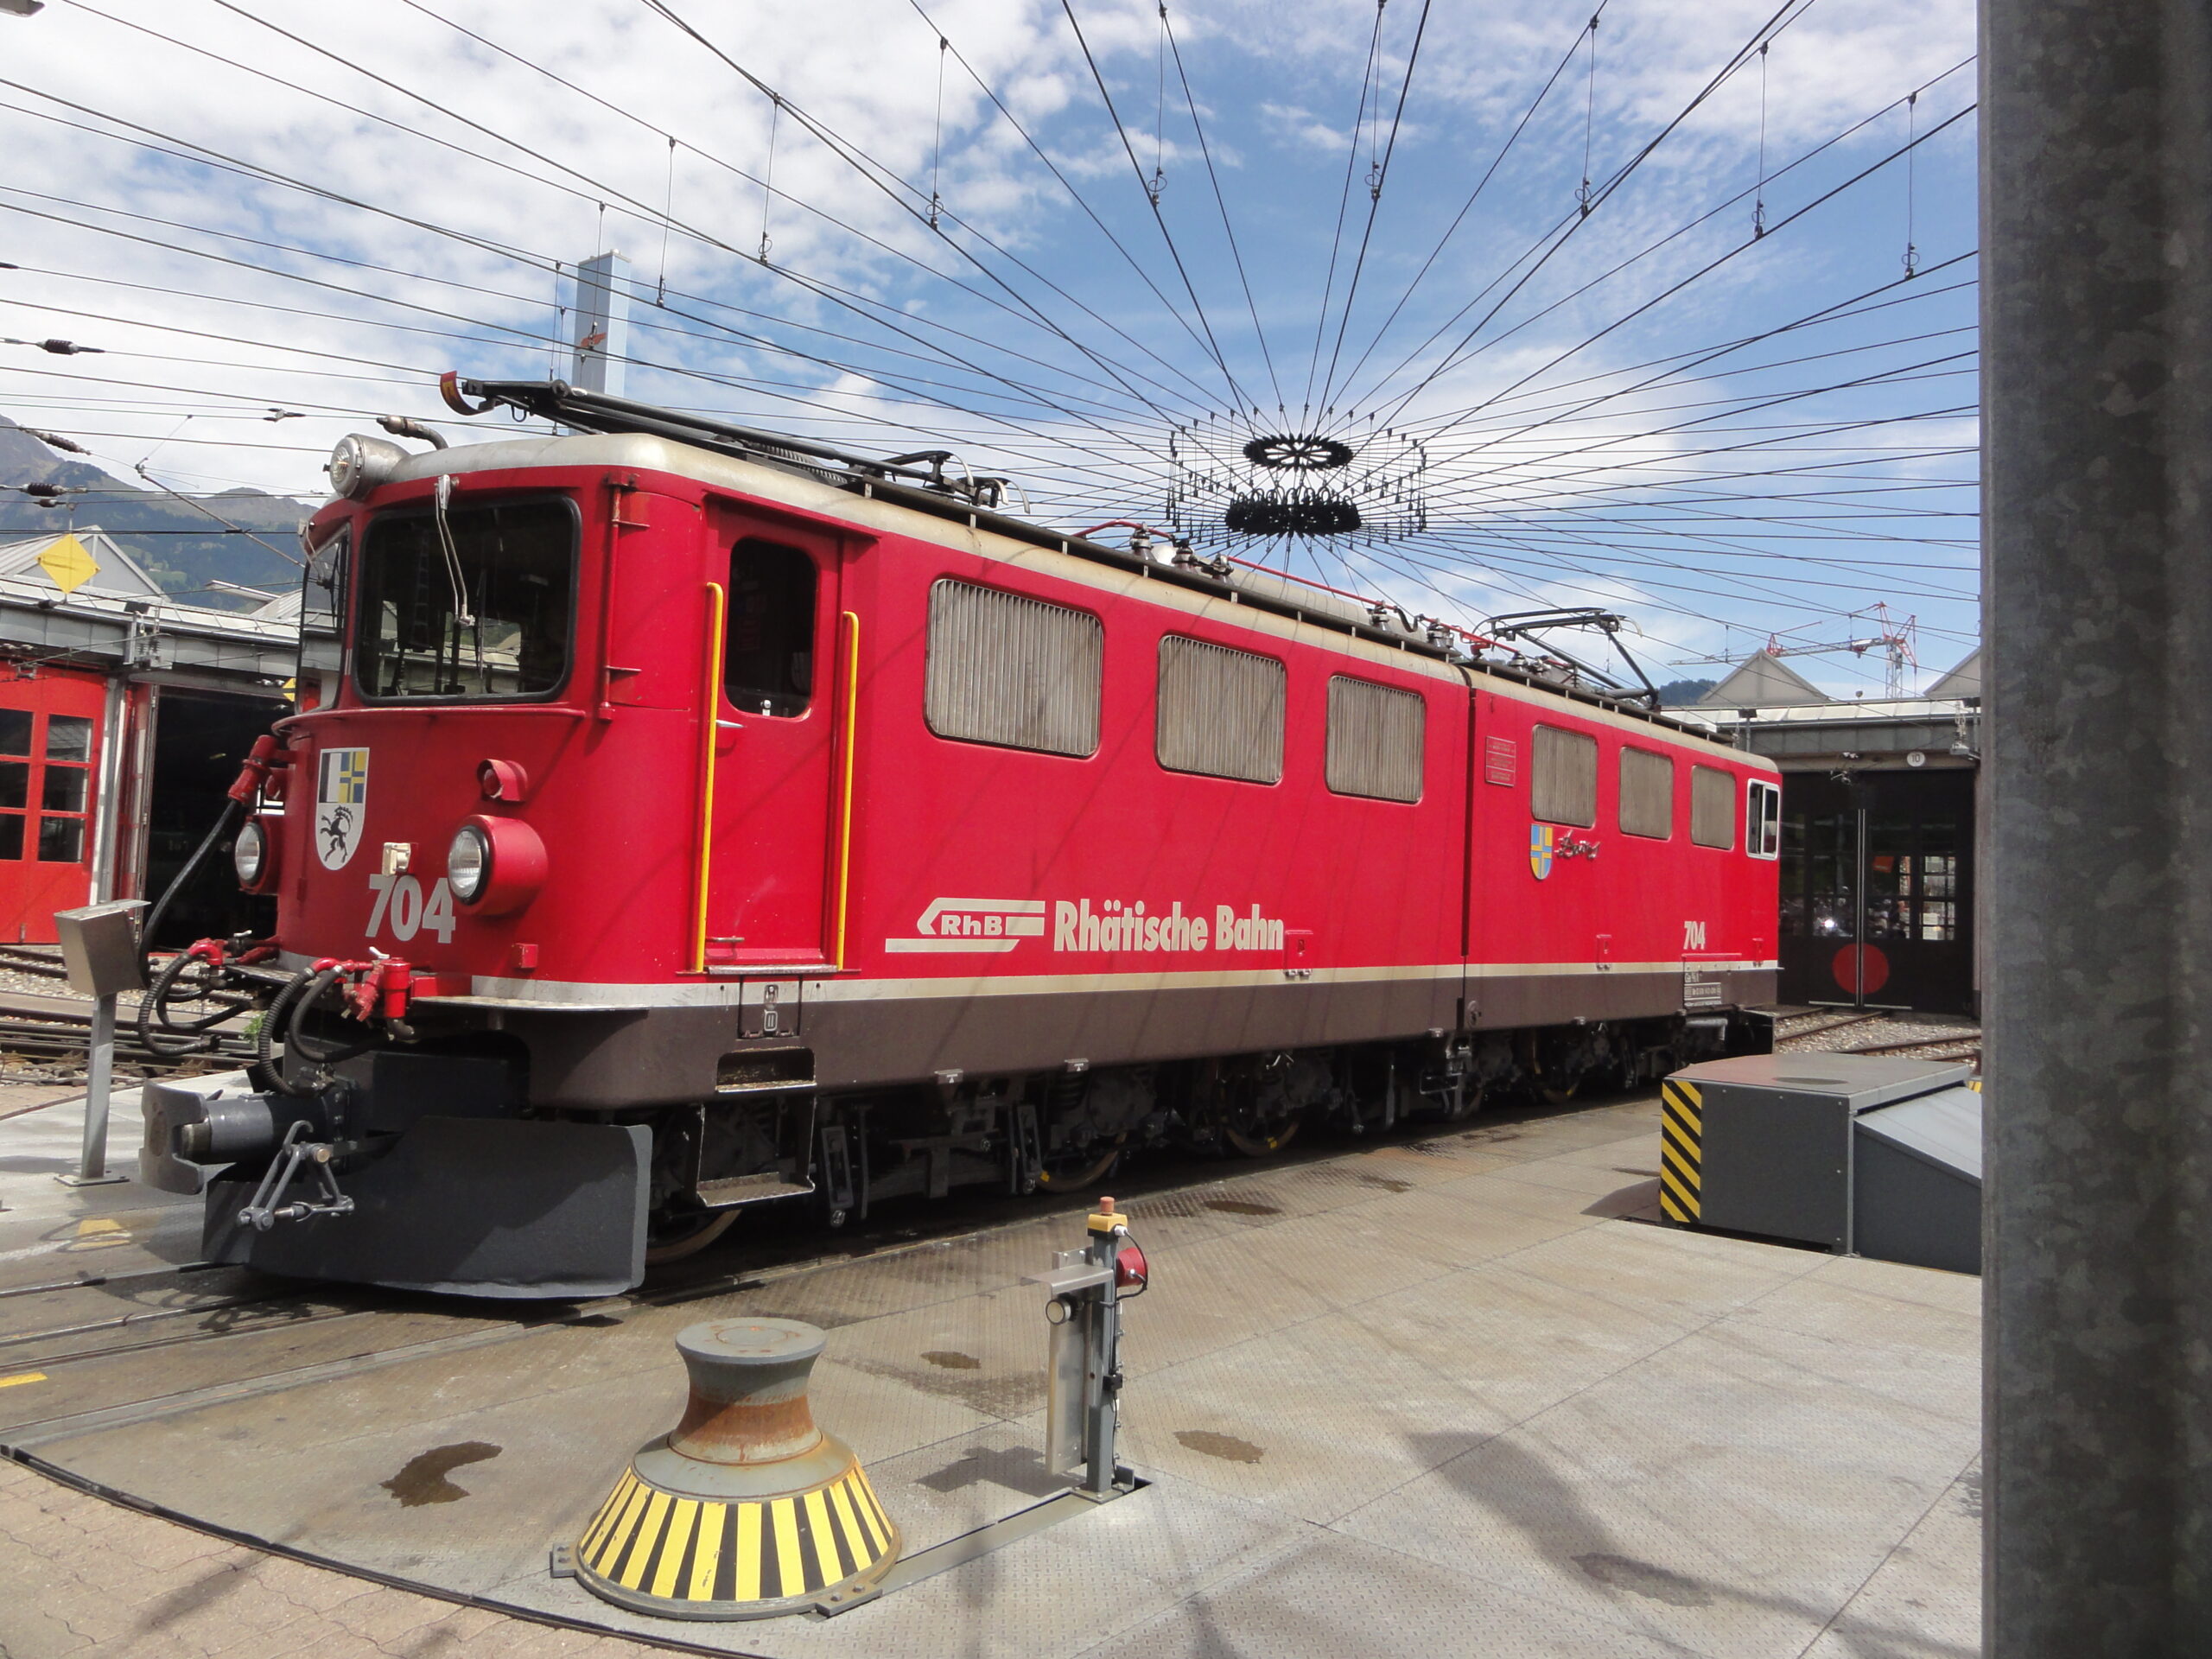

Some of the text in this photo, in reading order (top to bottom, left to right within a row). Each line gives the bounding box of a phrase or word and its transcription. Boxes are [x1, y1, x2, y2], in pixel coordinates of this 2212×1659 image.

[1911, 753, 1921, 763] 10
[365, 874, 455, 944] 704
[941, 914, 1002, 936] RhB
[1053, 899, 1284, 952] Rhätische Bahn
[1683, 920, 1706, 950] 704
